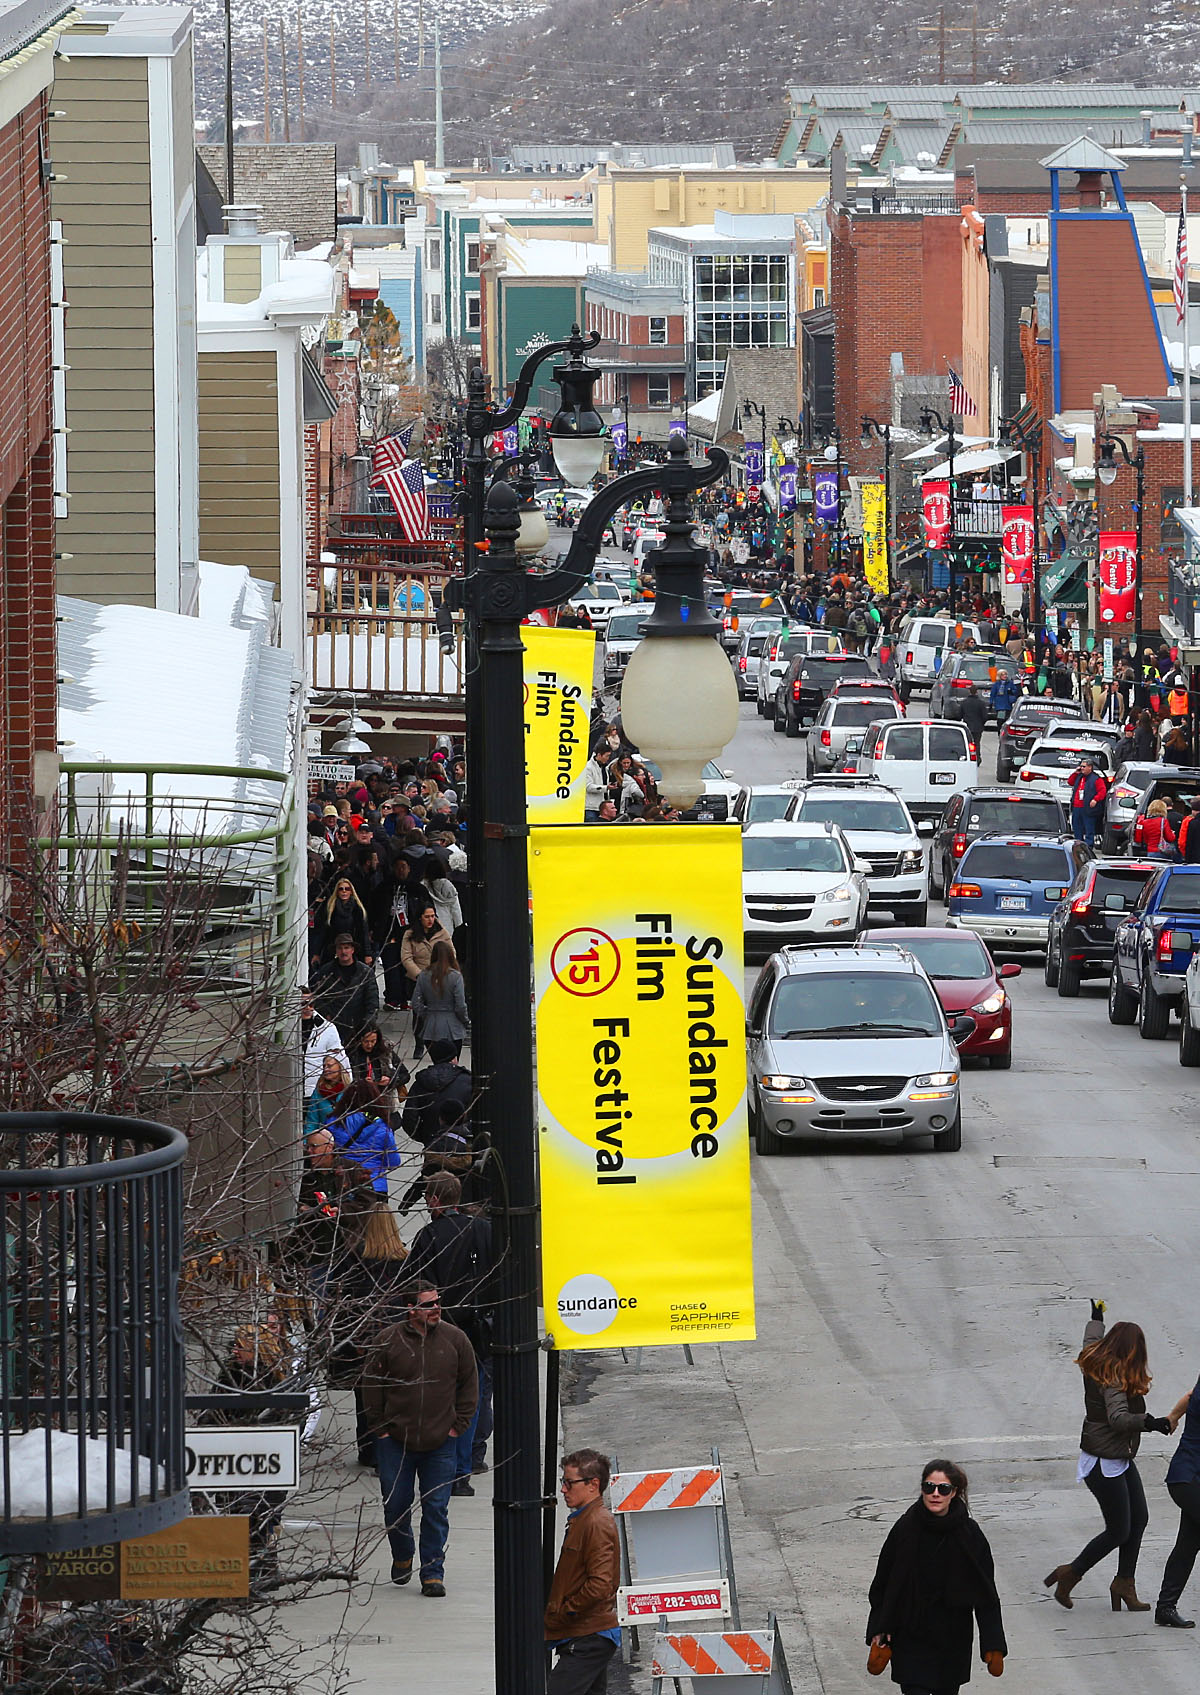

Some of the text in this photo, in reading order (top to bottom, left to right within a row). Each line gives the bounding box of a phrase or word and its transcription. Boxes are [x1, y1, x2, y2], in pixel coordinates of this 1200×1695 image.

[535, 671, 557, 717] Film
[556, 684, 581, 799] Sundance
[635, 913, 676, 1001] Film
[685, 935, 729, 1160] Sundance
[592, 1017, 637, 1185] Festival
[557, 1296, 637, 1312] sundance
[670, 1303, 698, 1311] CHASE
[670, 1311, 740, 1323] SAPPHIRE
[45, 1557, 243, 1576] FARGO MORTGAGE
[46, 1543, 188, 1561] WELLS HOME
